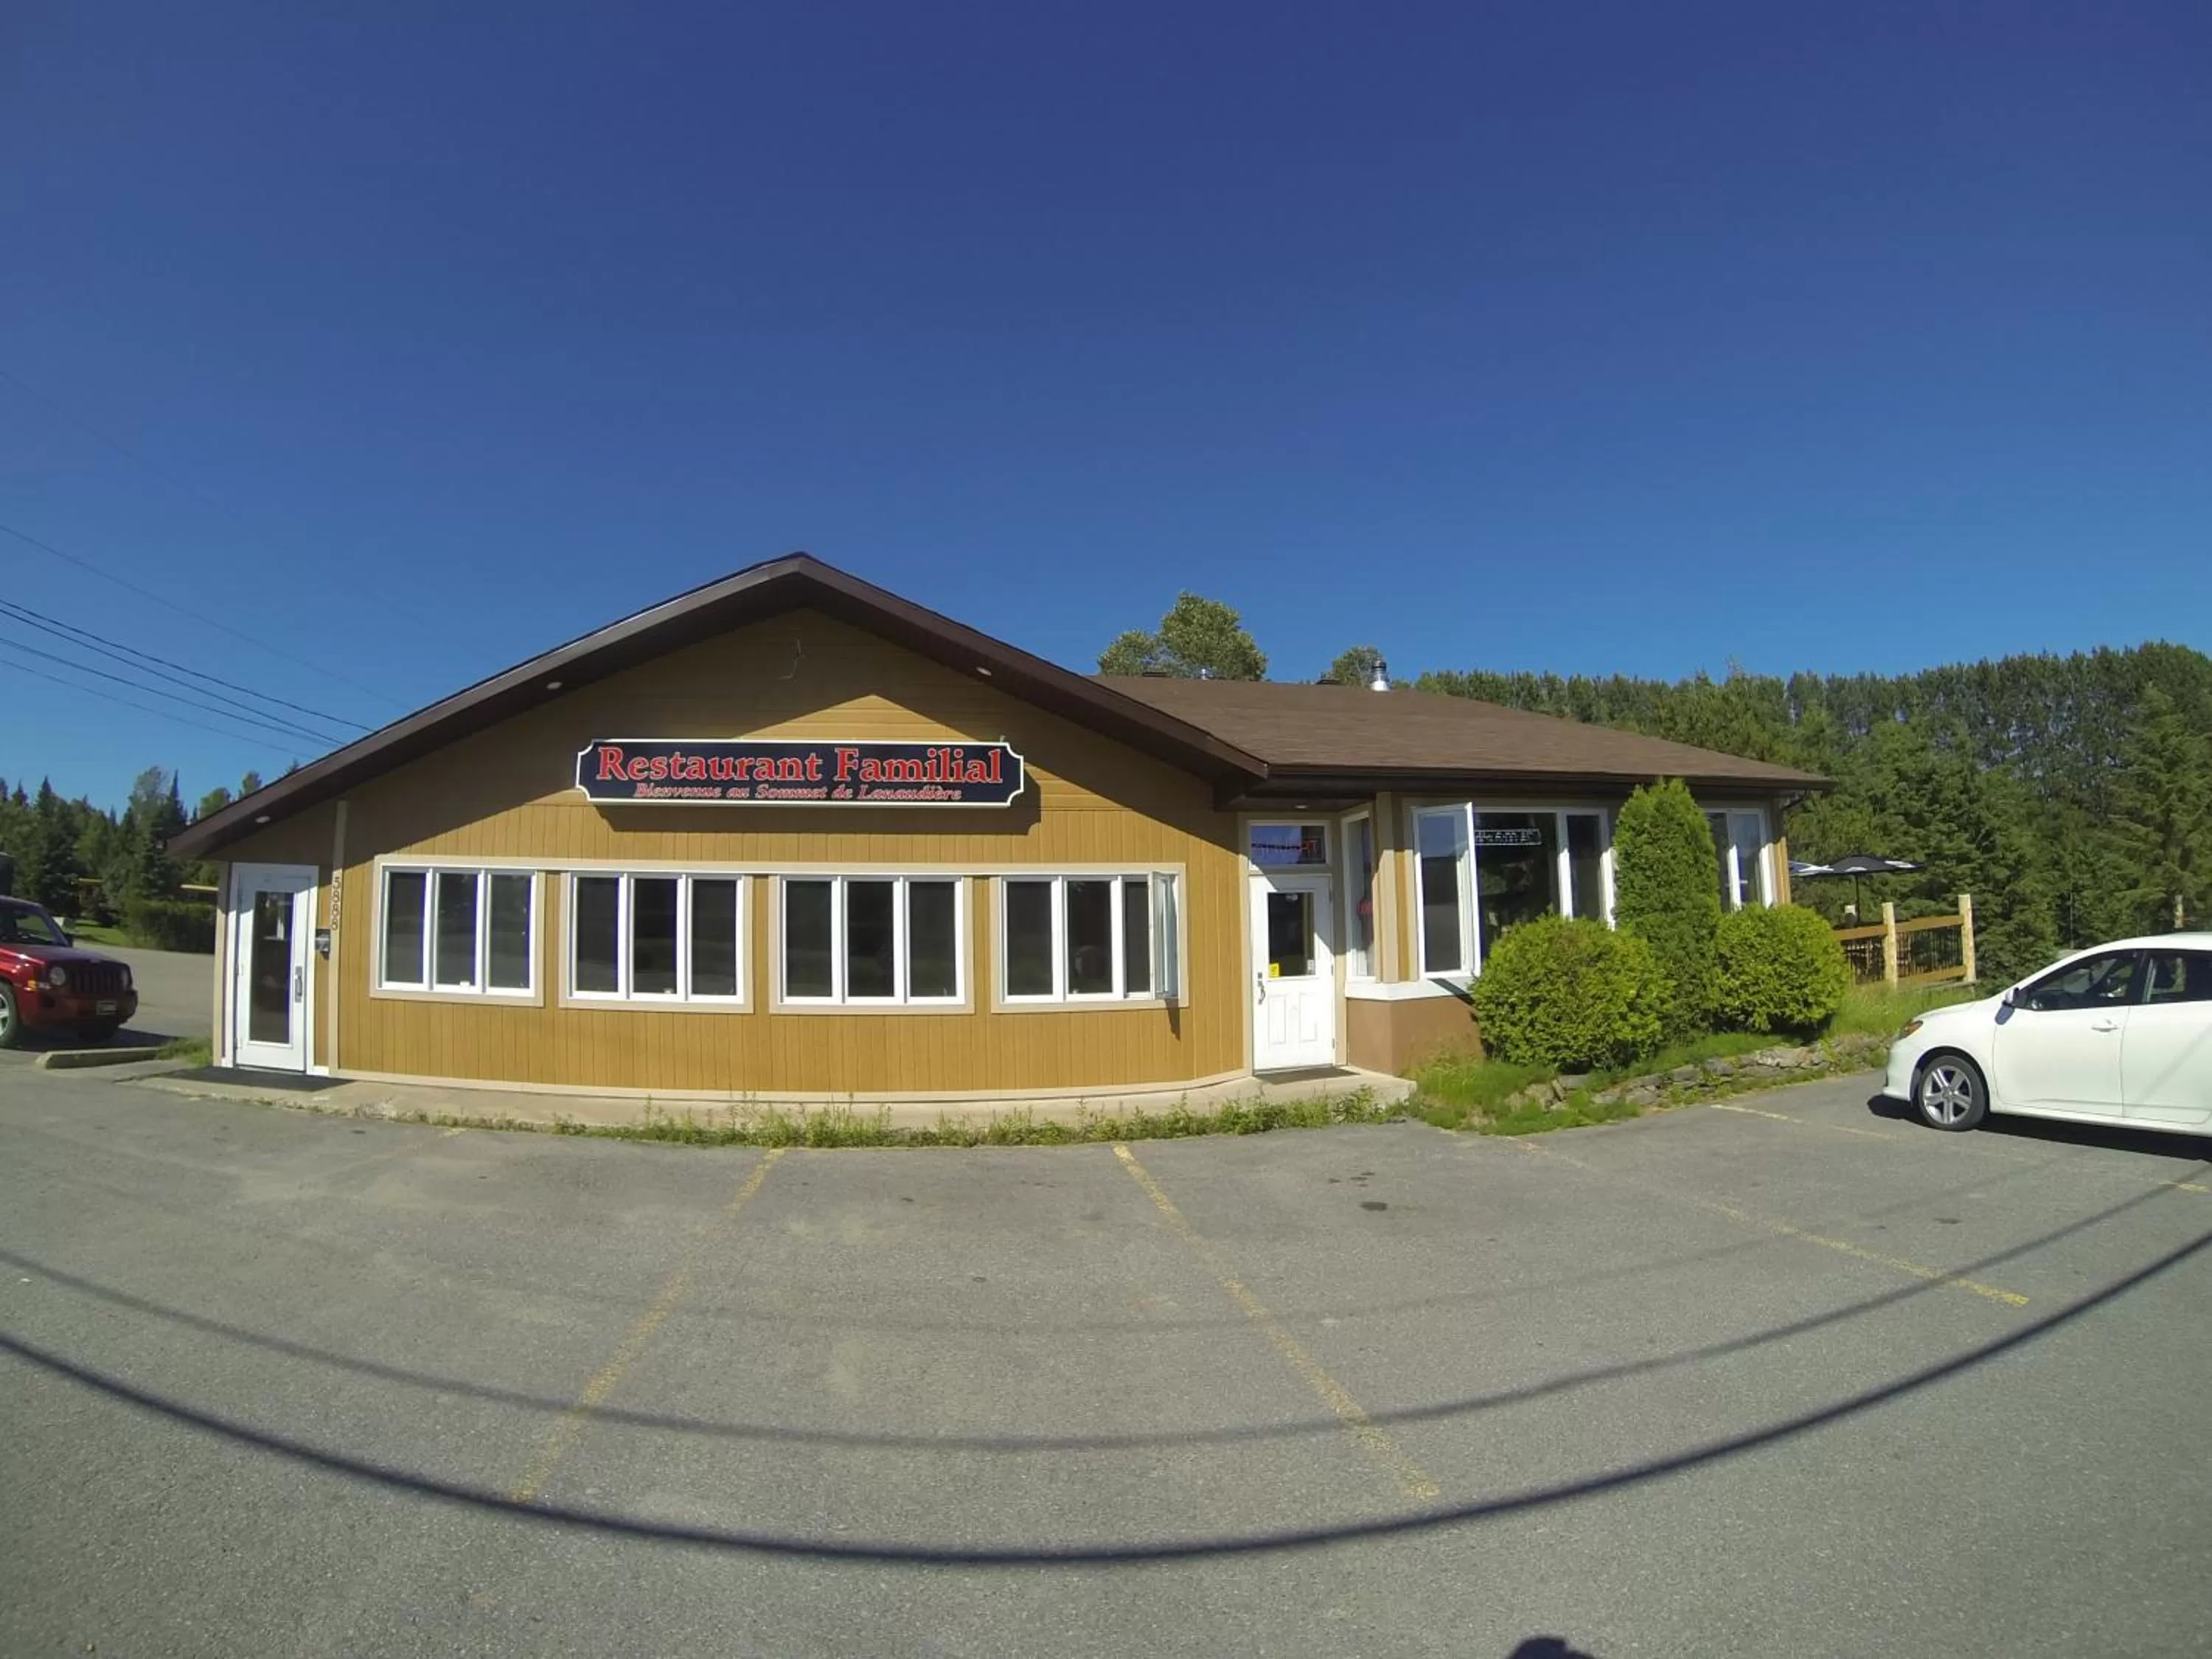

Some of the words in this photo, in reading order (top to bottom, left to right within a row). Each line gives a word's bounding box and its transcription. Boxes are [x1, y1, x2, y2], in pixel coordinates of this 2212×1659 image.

[597, 746, 823, 781] Restaurant
[833, 747, 1003, 783] Familial
[633, 782, 722, 799] Bienvenue
[726, 787, 750, 799] au
[755, 784, 827, 799] Sommet
[832, 784, 853, 799] de
